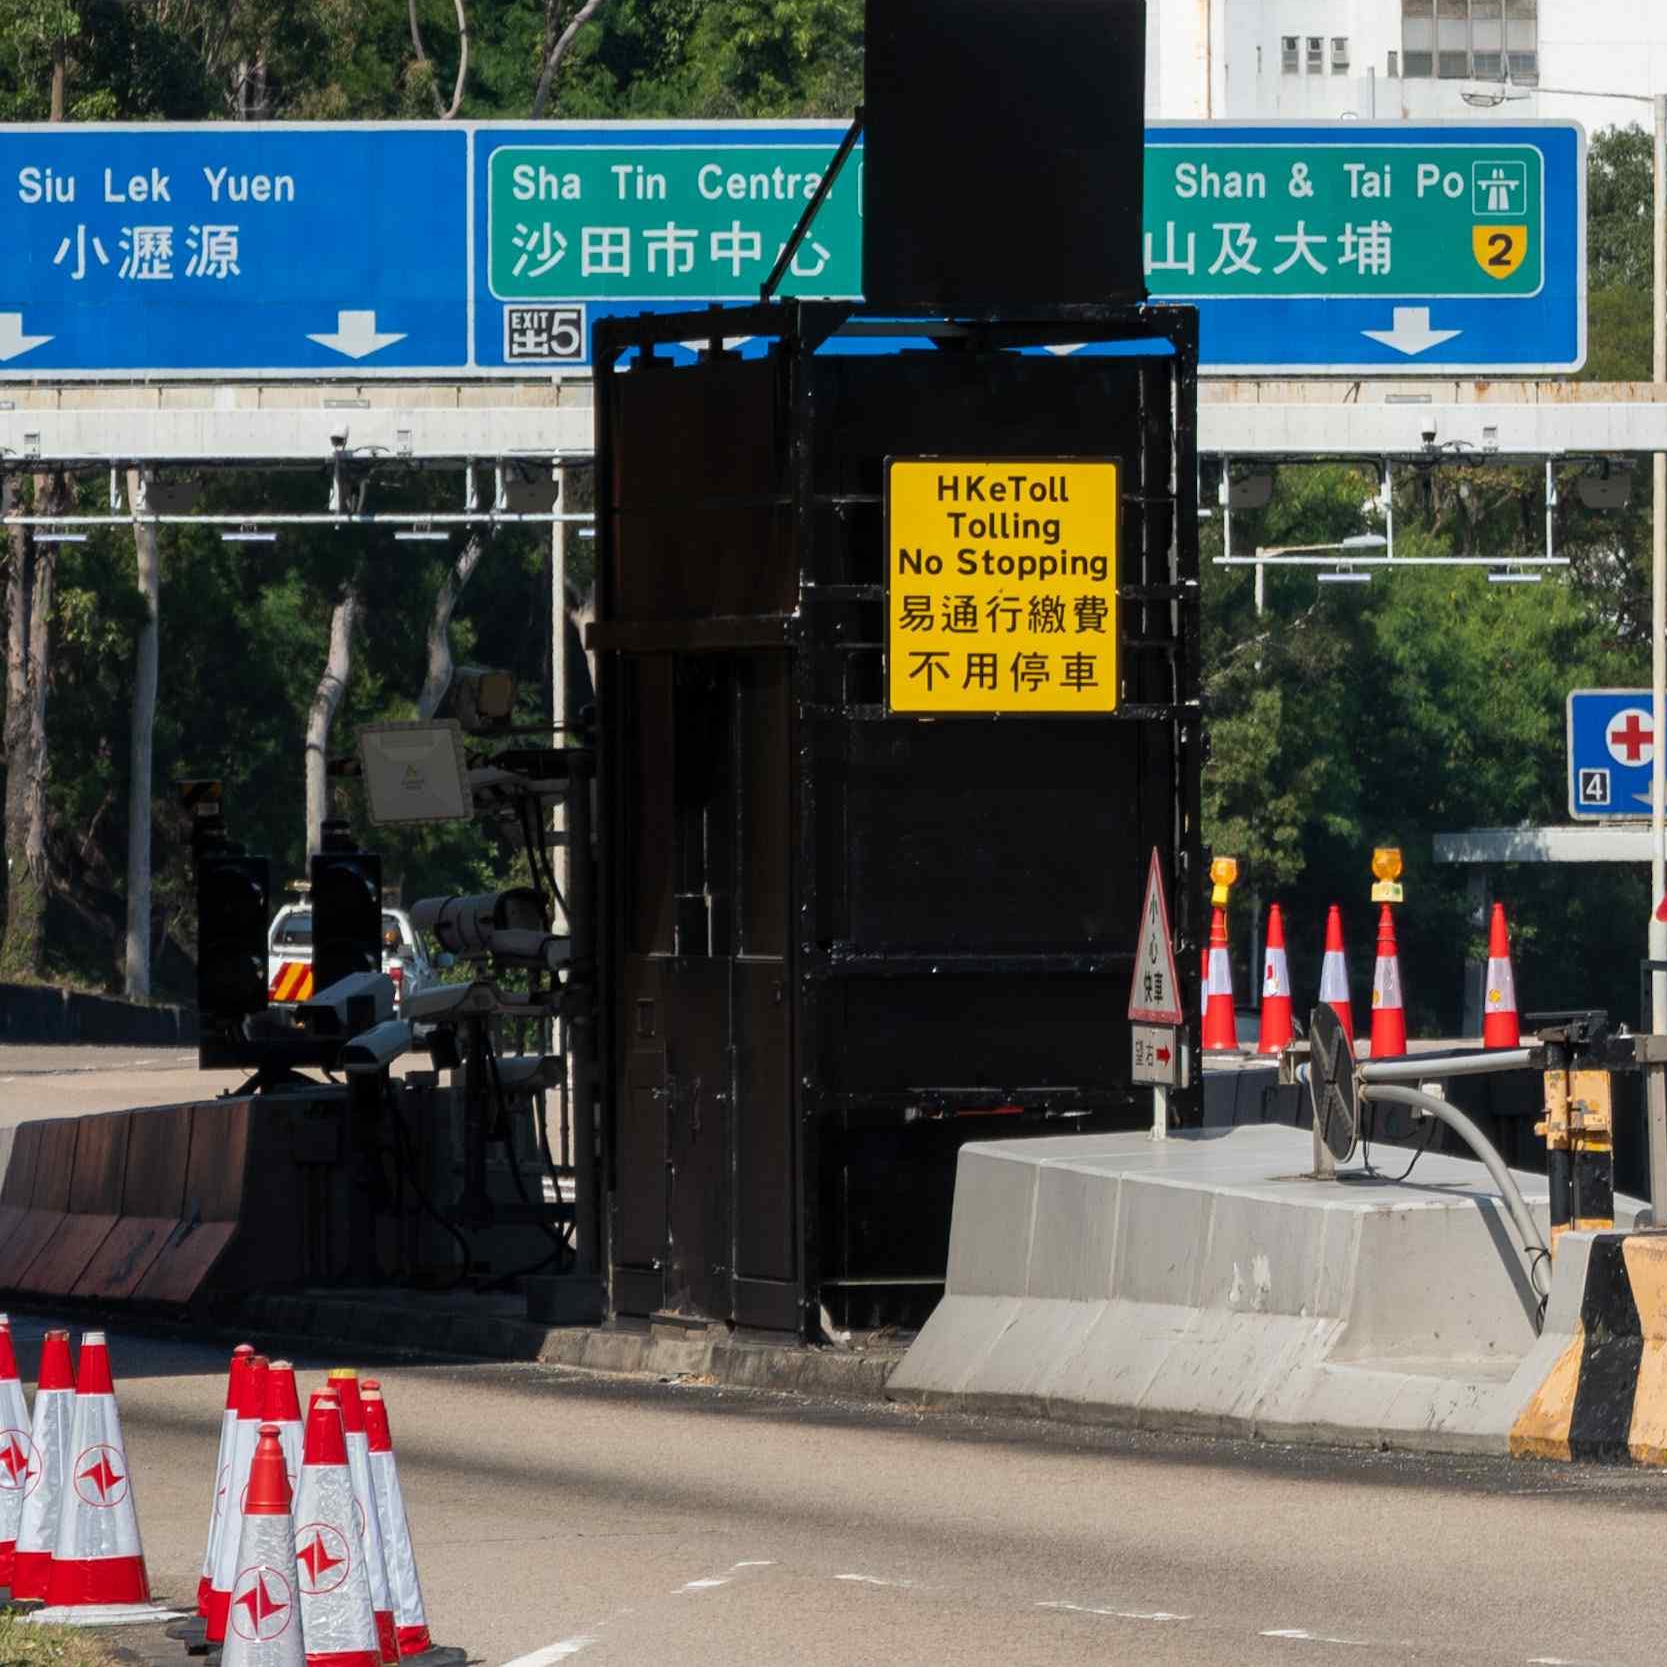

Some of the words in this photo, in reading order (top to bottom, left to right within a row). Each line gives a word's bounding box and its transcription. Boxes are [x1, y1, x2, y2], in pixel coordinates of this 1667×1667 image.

[18, 166, 75, 204] Siu
[104, 167, 171, 203] Lek
[203, 167, 295, 202] Yuen
[512, 164, 581, 201] Sha
[611, 164, 667, 200] Tin
[698, 163, 832, 200] Centra
[1175, 162, 1266, 199] Shan
[1288, 162, 1314, 198] &
[1343, 163, 1391, 198] Tai
[1417, 163, 1465, 198] Po
[53, 224, 241, 280] 小瀝源
[511, 220, 831, 278] 沙田市中心
[1144, 220, 1393, 276] 山及大埔
[1488, 233, 1513, 267] 2
[511, 311, 549, 329] EXIT
[550, 311, 580, 355] 5
[511, 329, 549, 356] 出
[937, 475, 1069, 503] HKeToll
[946, 512, 1061, 546] Tolling
[899, 548, 943, 575] No
[957, 548, 1108, 582] Stopping
[899, 594, 1109, 634] 易通行繳費
[908, 651, 1099, 693] 不用停車
[1585, 774, 1604, 802] 4
